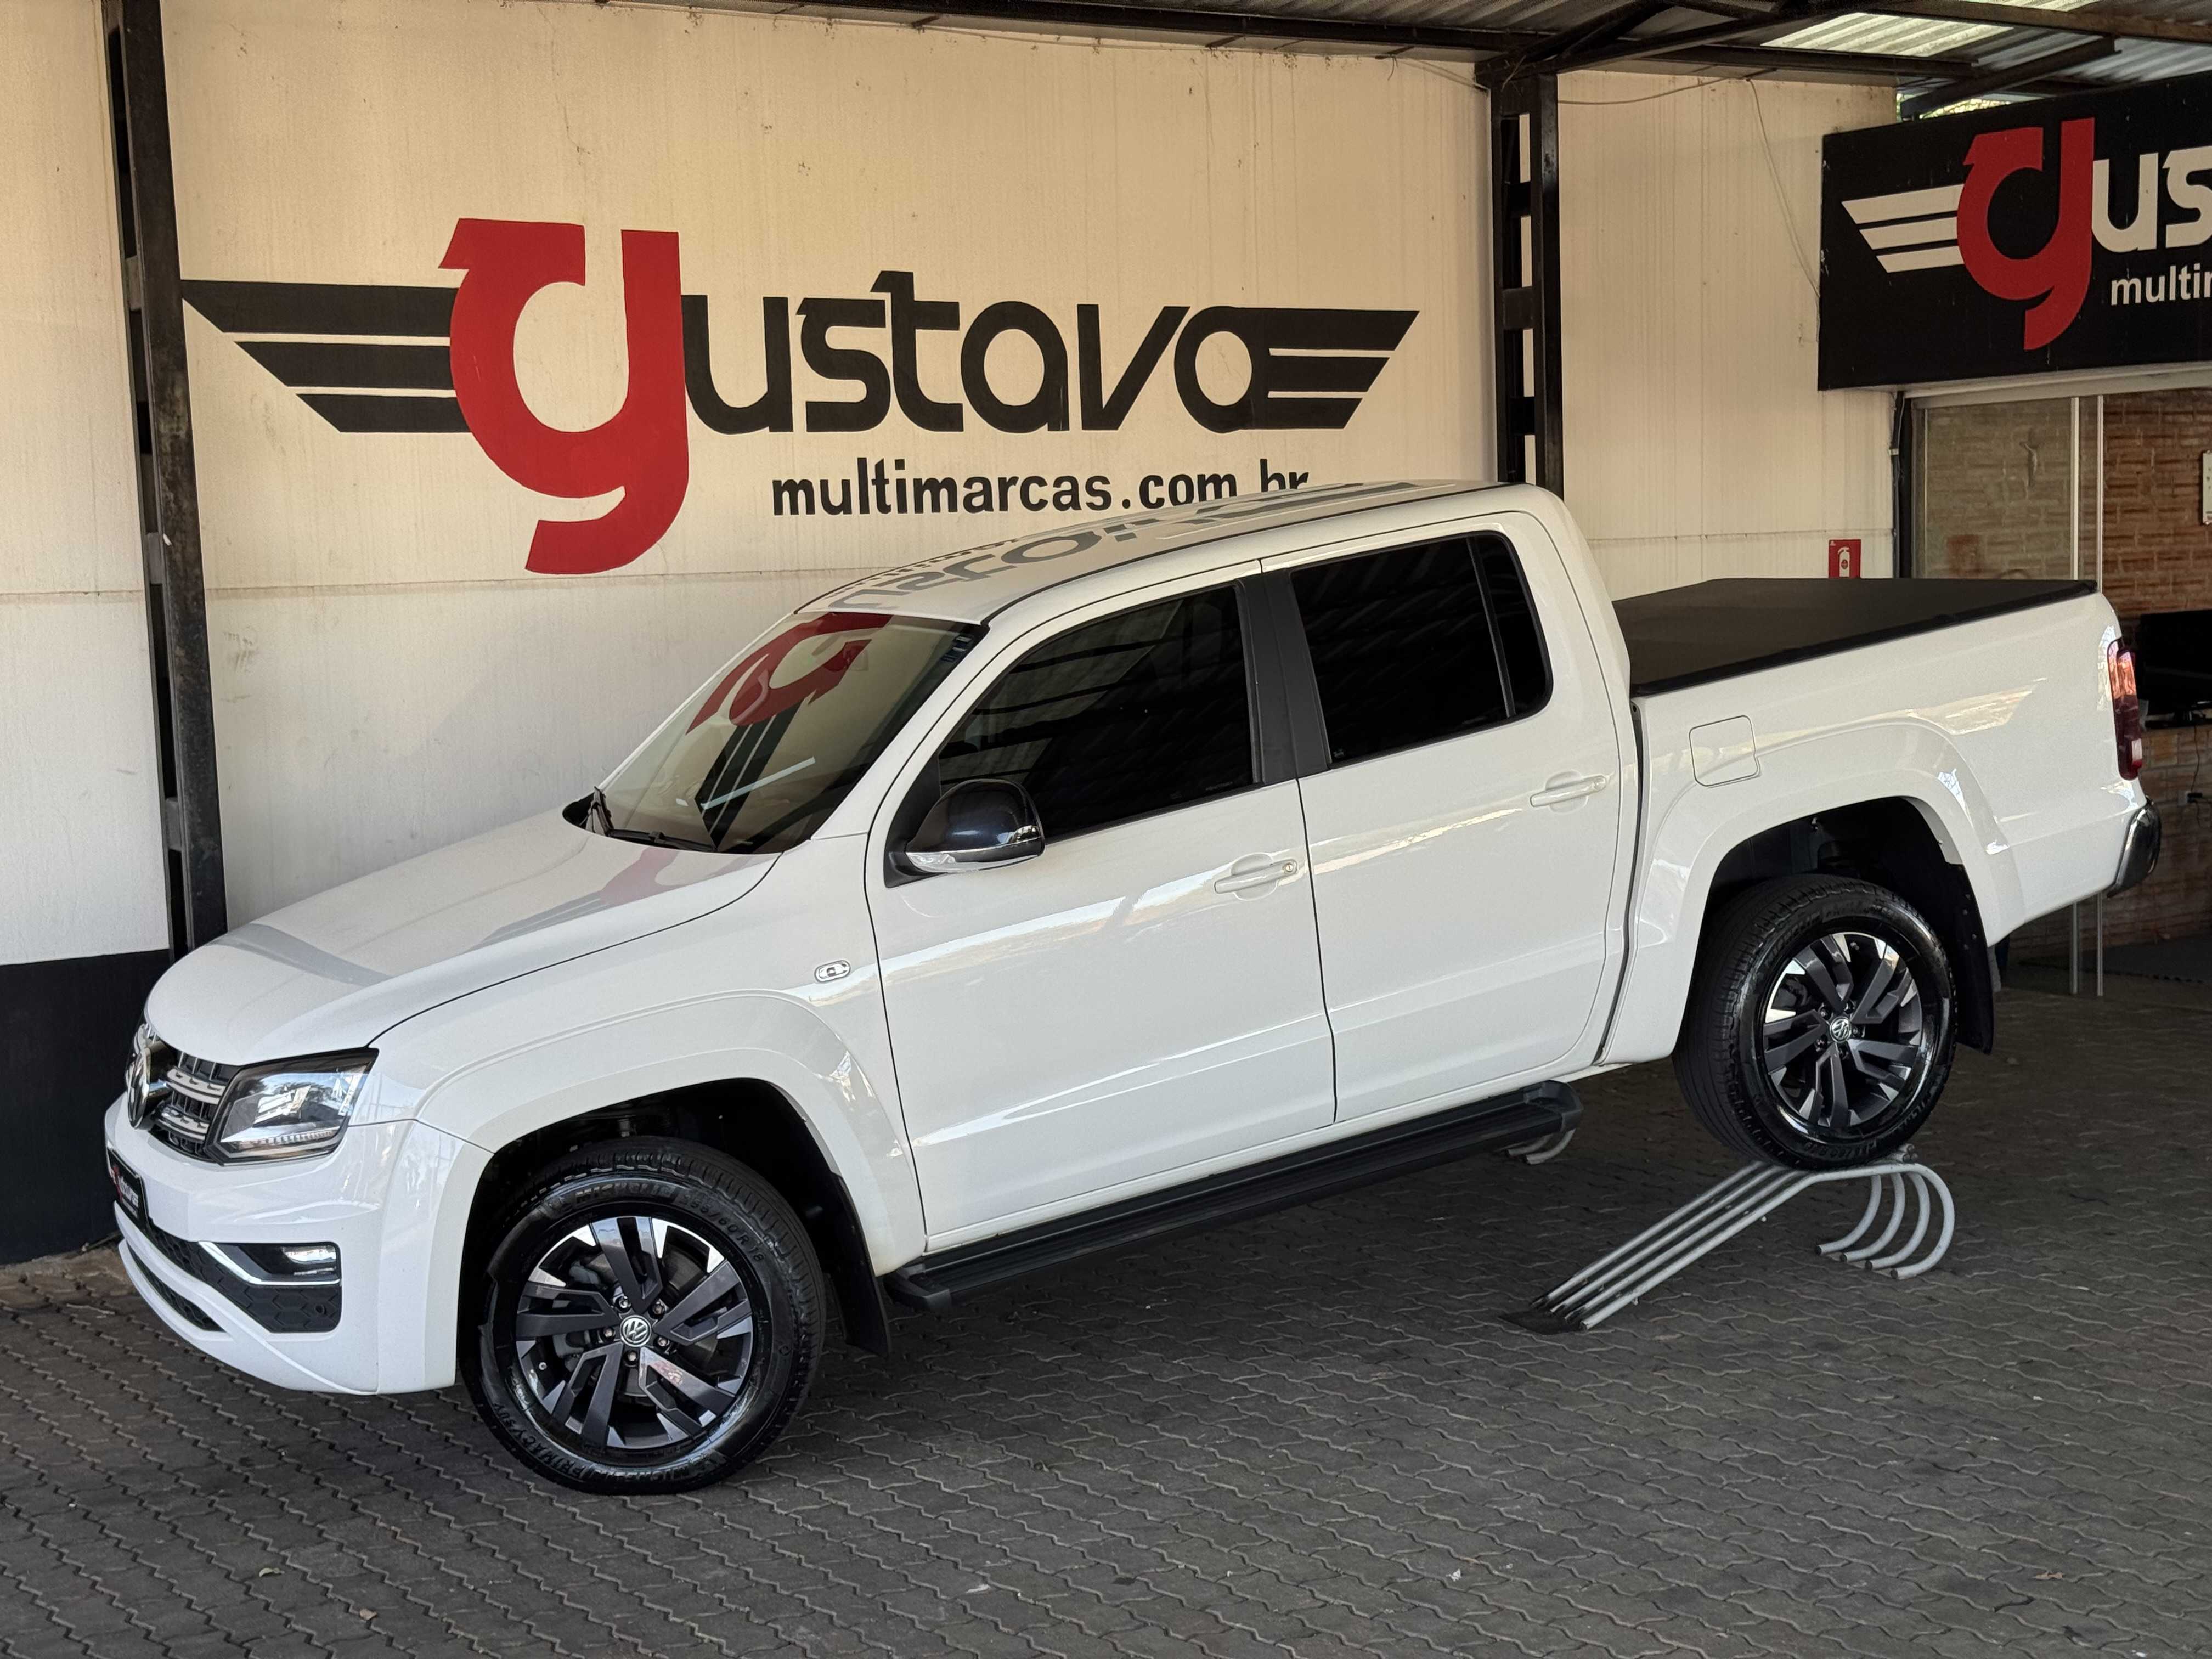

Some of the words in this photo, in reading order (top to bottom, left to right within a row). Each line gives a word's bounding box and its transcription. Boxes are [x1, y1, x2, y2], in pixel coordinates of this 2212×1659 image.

[2111, 263, 2212, 306] multi
[438, 218, 1262, 574] gustavo
[772, 457, 1309, 516] multimarcas.combr
